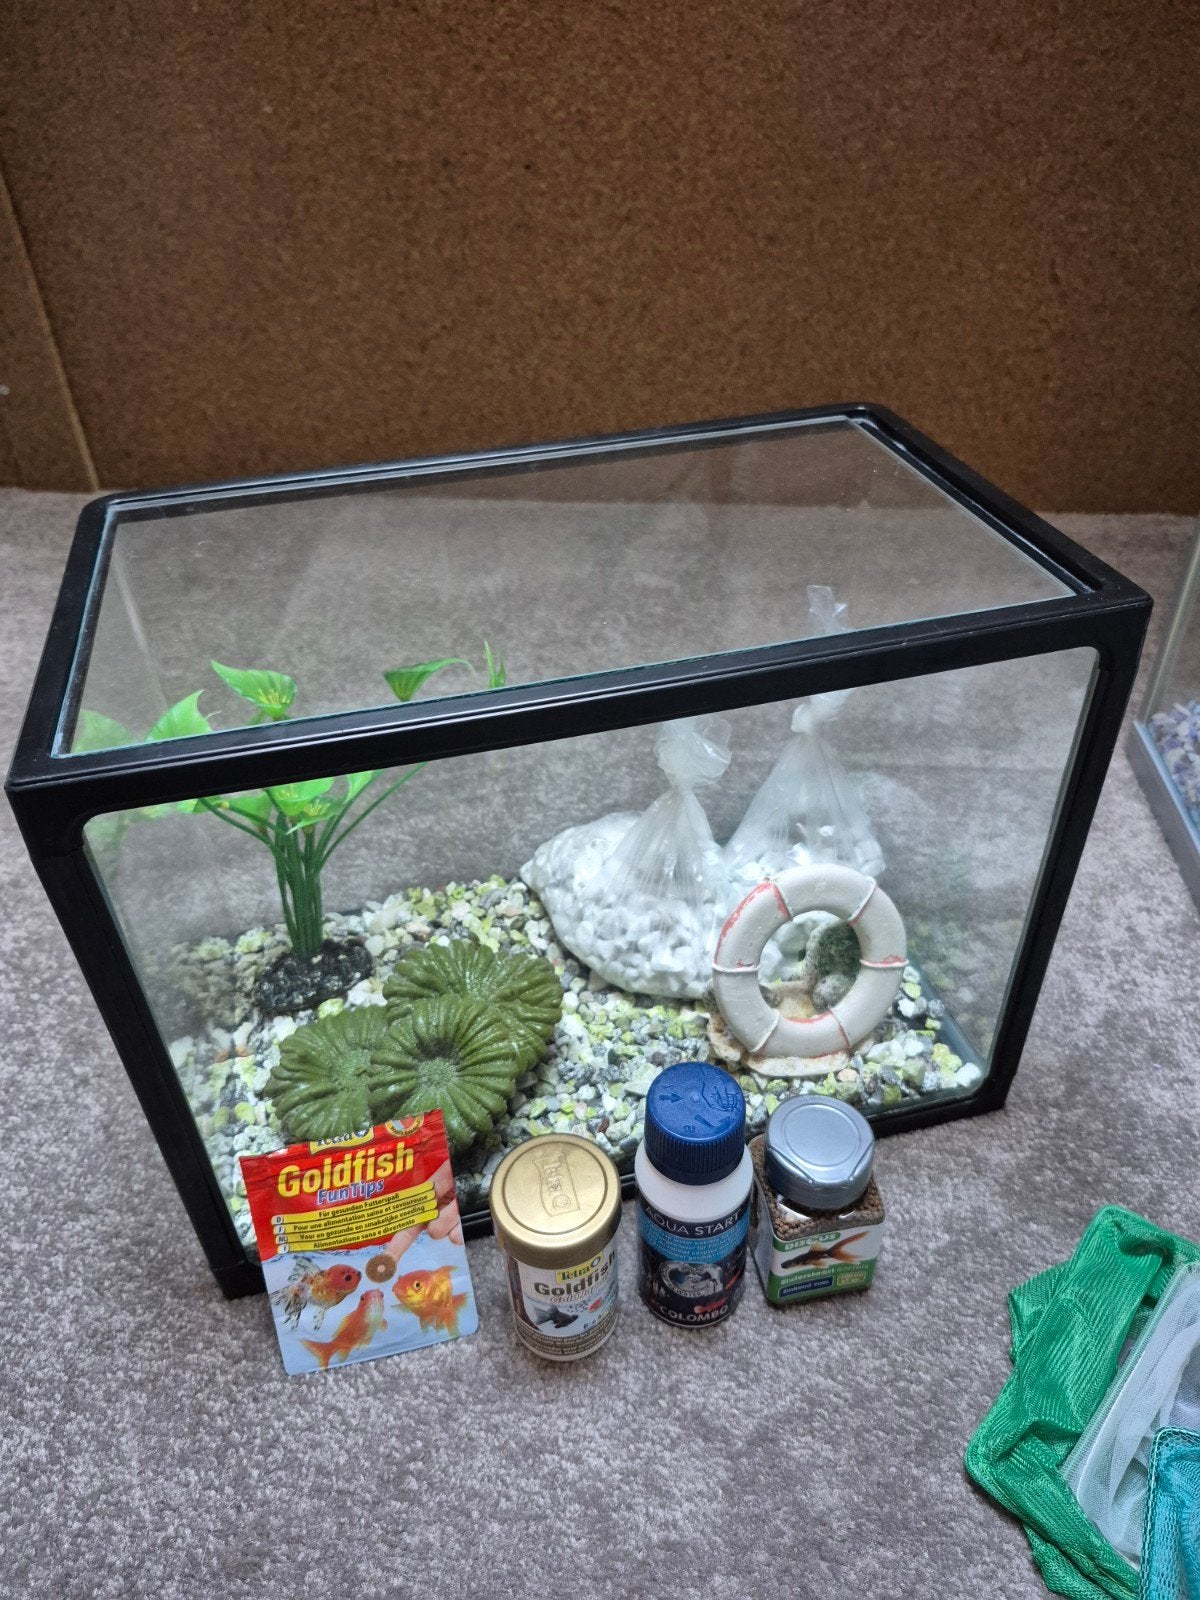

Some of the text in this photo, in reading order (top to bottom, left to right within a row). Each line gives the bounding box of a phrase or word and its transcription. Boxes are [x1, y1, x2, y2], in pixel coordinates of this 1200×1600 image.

[277, 1141, 414, 1198] Goldfish
[319, 1210, 330, 1218] Für
[331, 1203, 364, 1217] gesunden
[323, 1212, 366, 1227] alimentation
[366, 1208, 384, 1218] saine
[326, 1225, 354, 1238] gezonde
[364, 1214, 399, 1229] smakelijke
[400, 1205, 425, 1218] voeding
[645, 1206, 742, 1236] AQUA START
[313, 1235, 361, 1249] Alimentazione
[361, 1231, 377, 1240] sana
[383, 1218, 416, 1234] divertente
[557, 1265, 590, 1281] Tetra
[659, 1304, 729, 1323] COLOMBO
